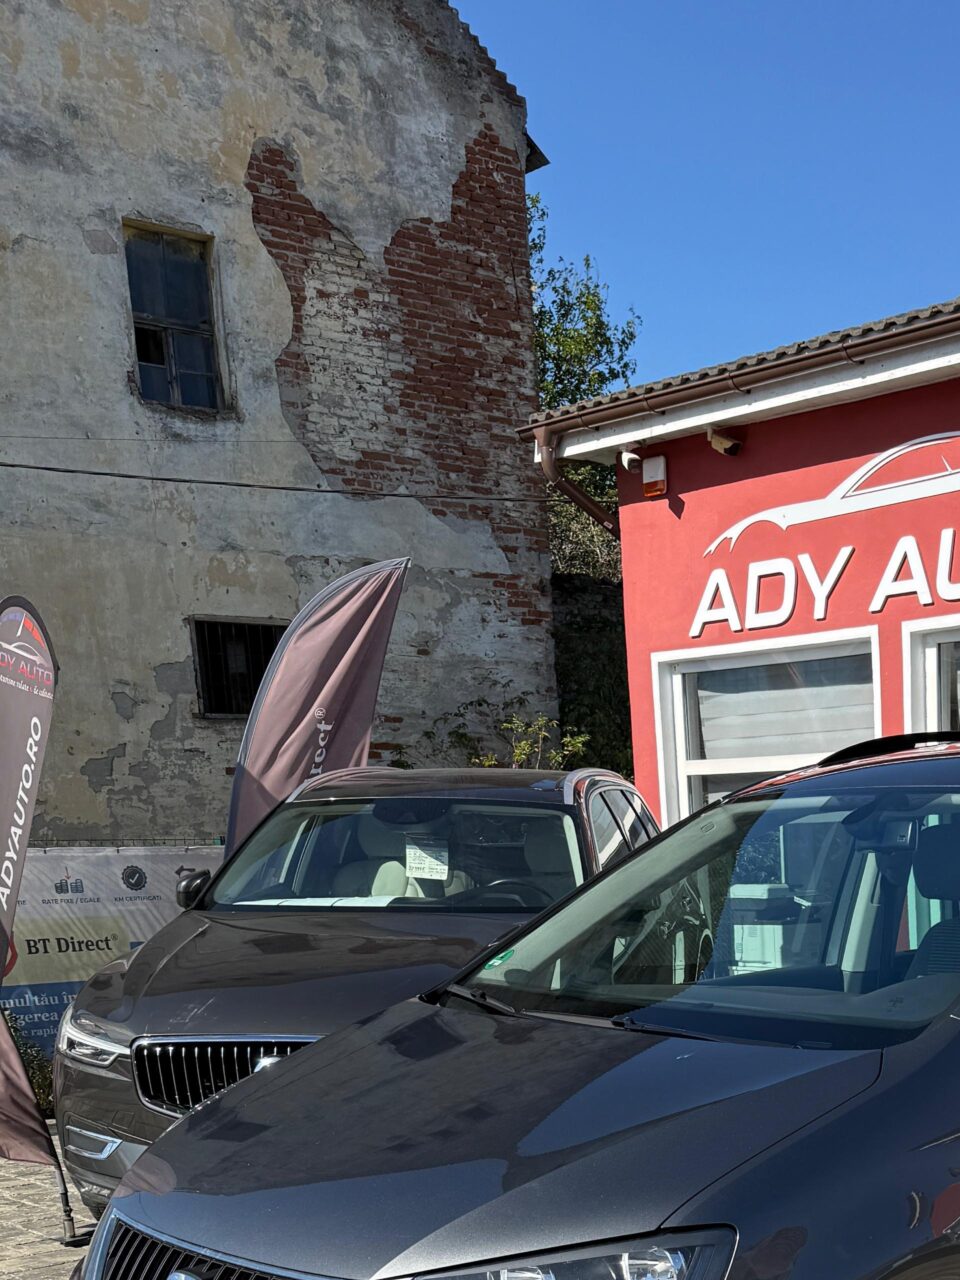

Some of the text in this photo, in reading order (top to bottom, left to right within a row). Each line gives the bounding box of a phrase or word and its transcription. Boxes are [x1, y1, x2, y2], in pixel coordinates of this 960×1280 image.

[689, 545, 855, 637] ADY
[18, 660, 53, 686] AUTO
[0, 716, 42, 911] ADYAUTO.RO
[25, 938, 50, 954] BT
[34, 992, 59, 1006] tău
